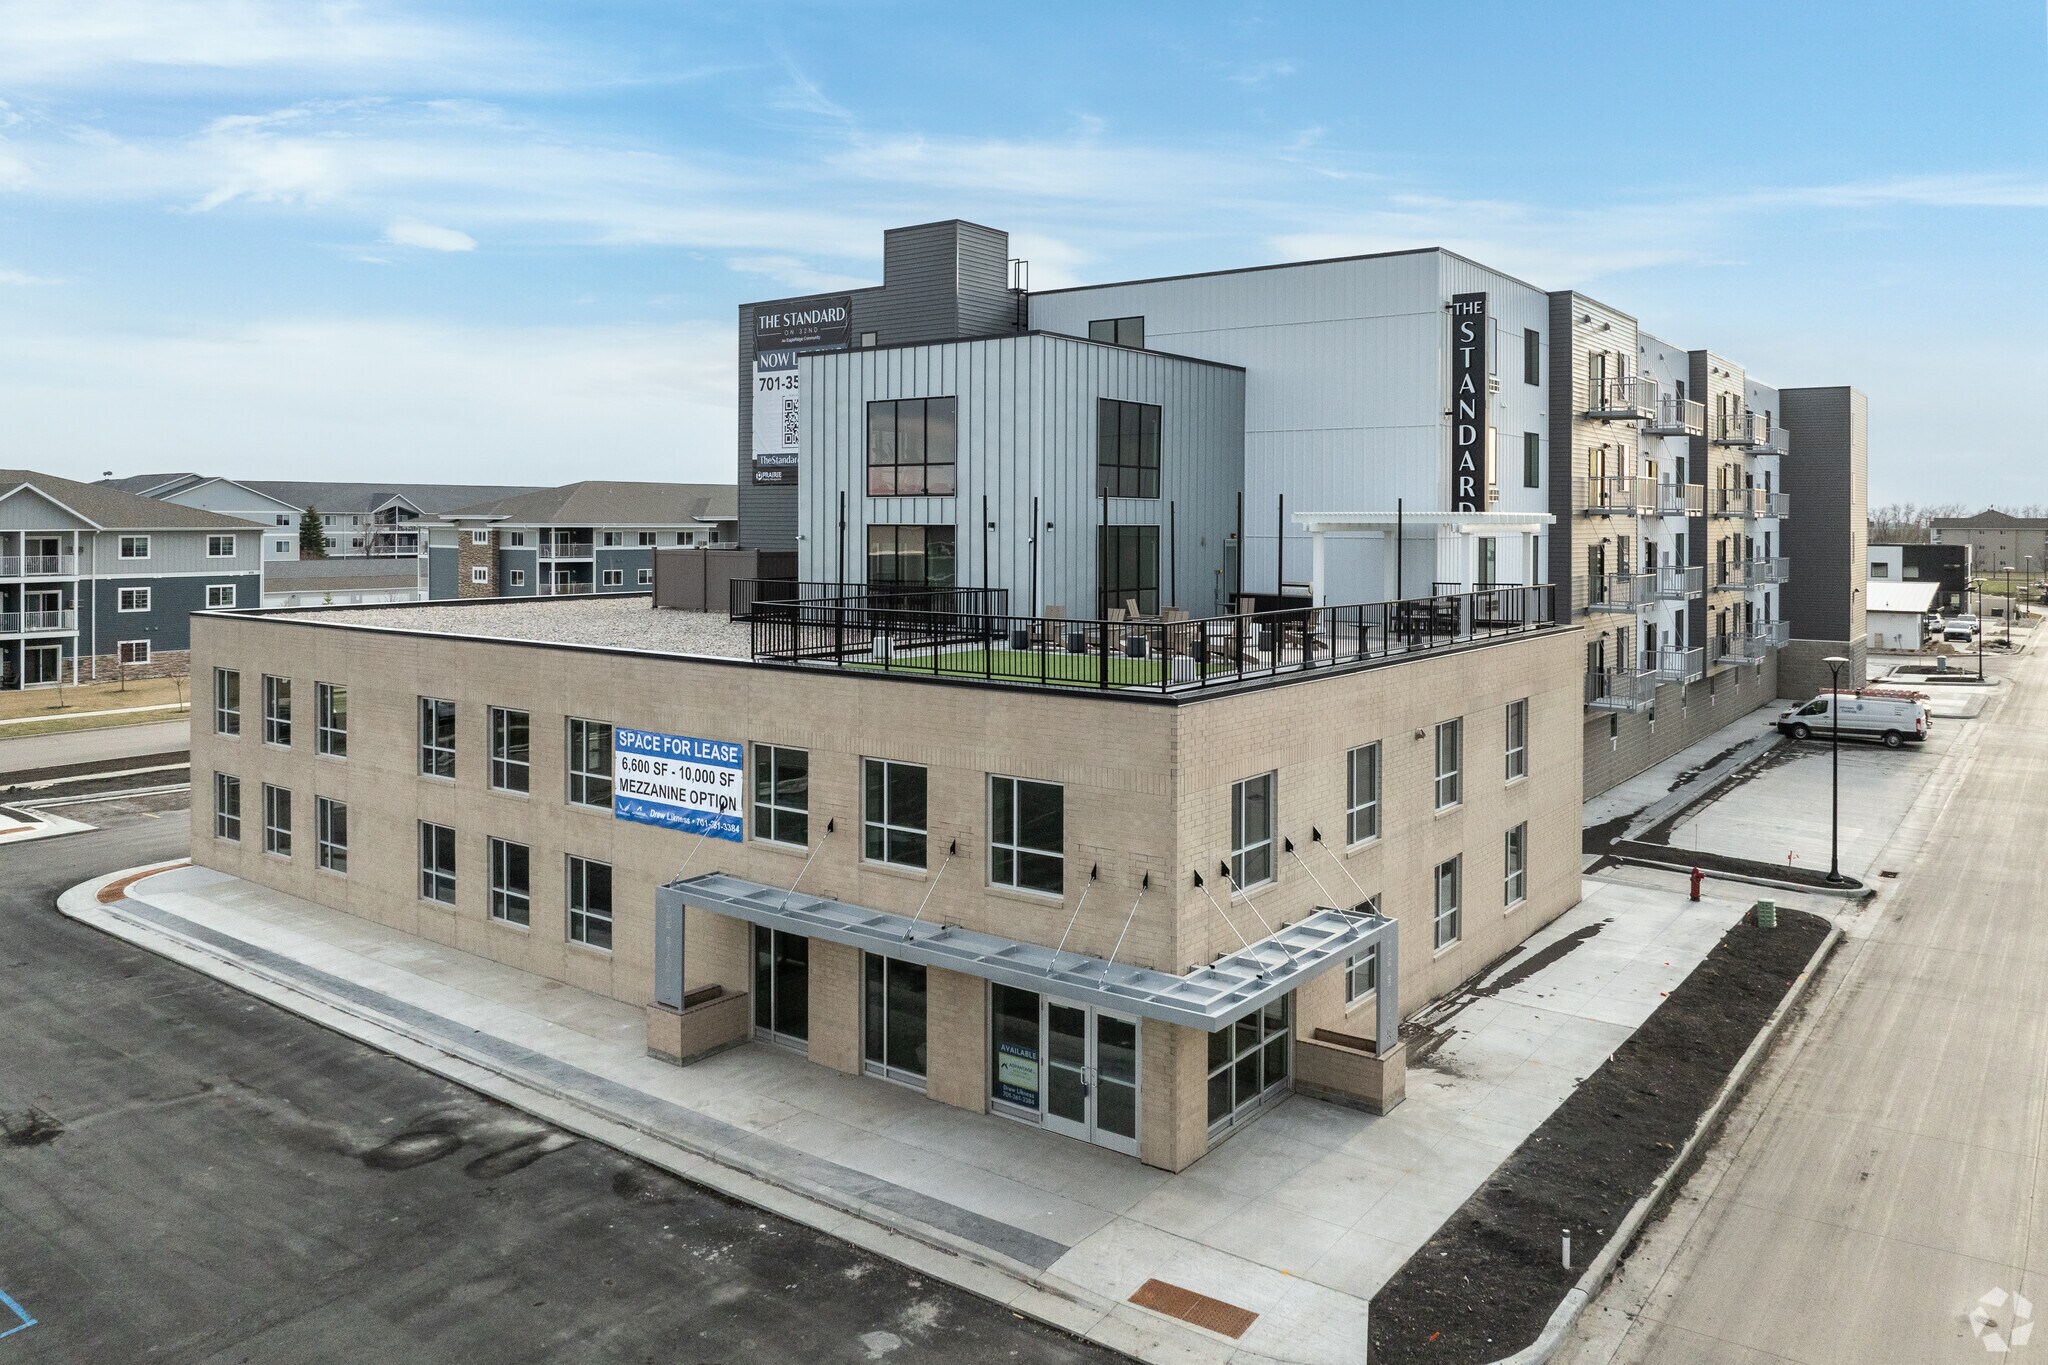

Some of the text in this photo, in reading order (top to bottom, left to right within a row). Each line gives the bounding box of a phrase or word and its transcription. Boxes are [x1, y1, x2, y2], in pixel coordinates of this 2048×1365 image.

[1453, 301, 1483, 315] THE
[759, 307, 845, 329] THE STANDARD
[799, 327, 818, 335] 32ND
[760, 352, 789, 368] NOW
[760, 455, 799, 465] TheStandar
[619, 731, 738, 763] SPACE FOR LEASE
[621, 756, 650, 773] 6,600
[653, 761, 668, 776] SF
[679, 765, 715, 784] 10,000
[719, 772, 735, 788] SF
[619, 777, 737, 811] MEZZANINE OPTION
[650, 809, 666, 820] Drew
[1001, 1044, 1036, 1060] AVAILABLE
